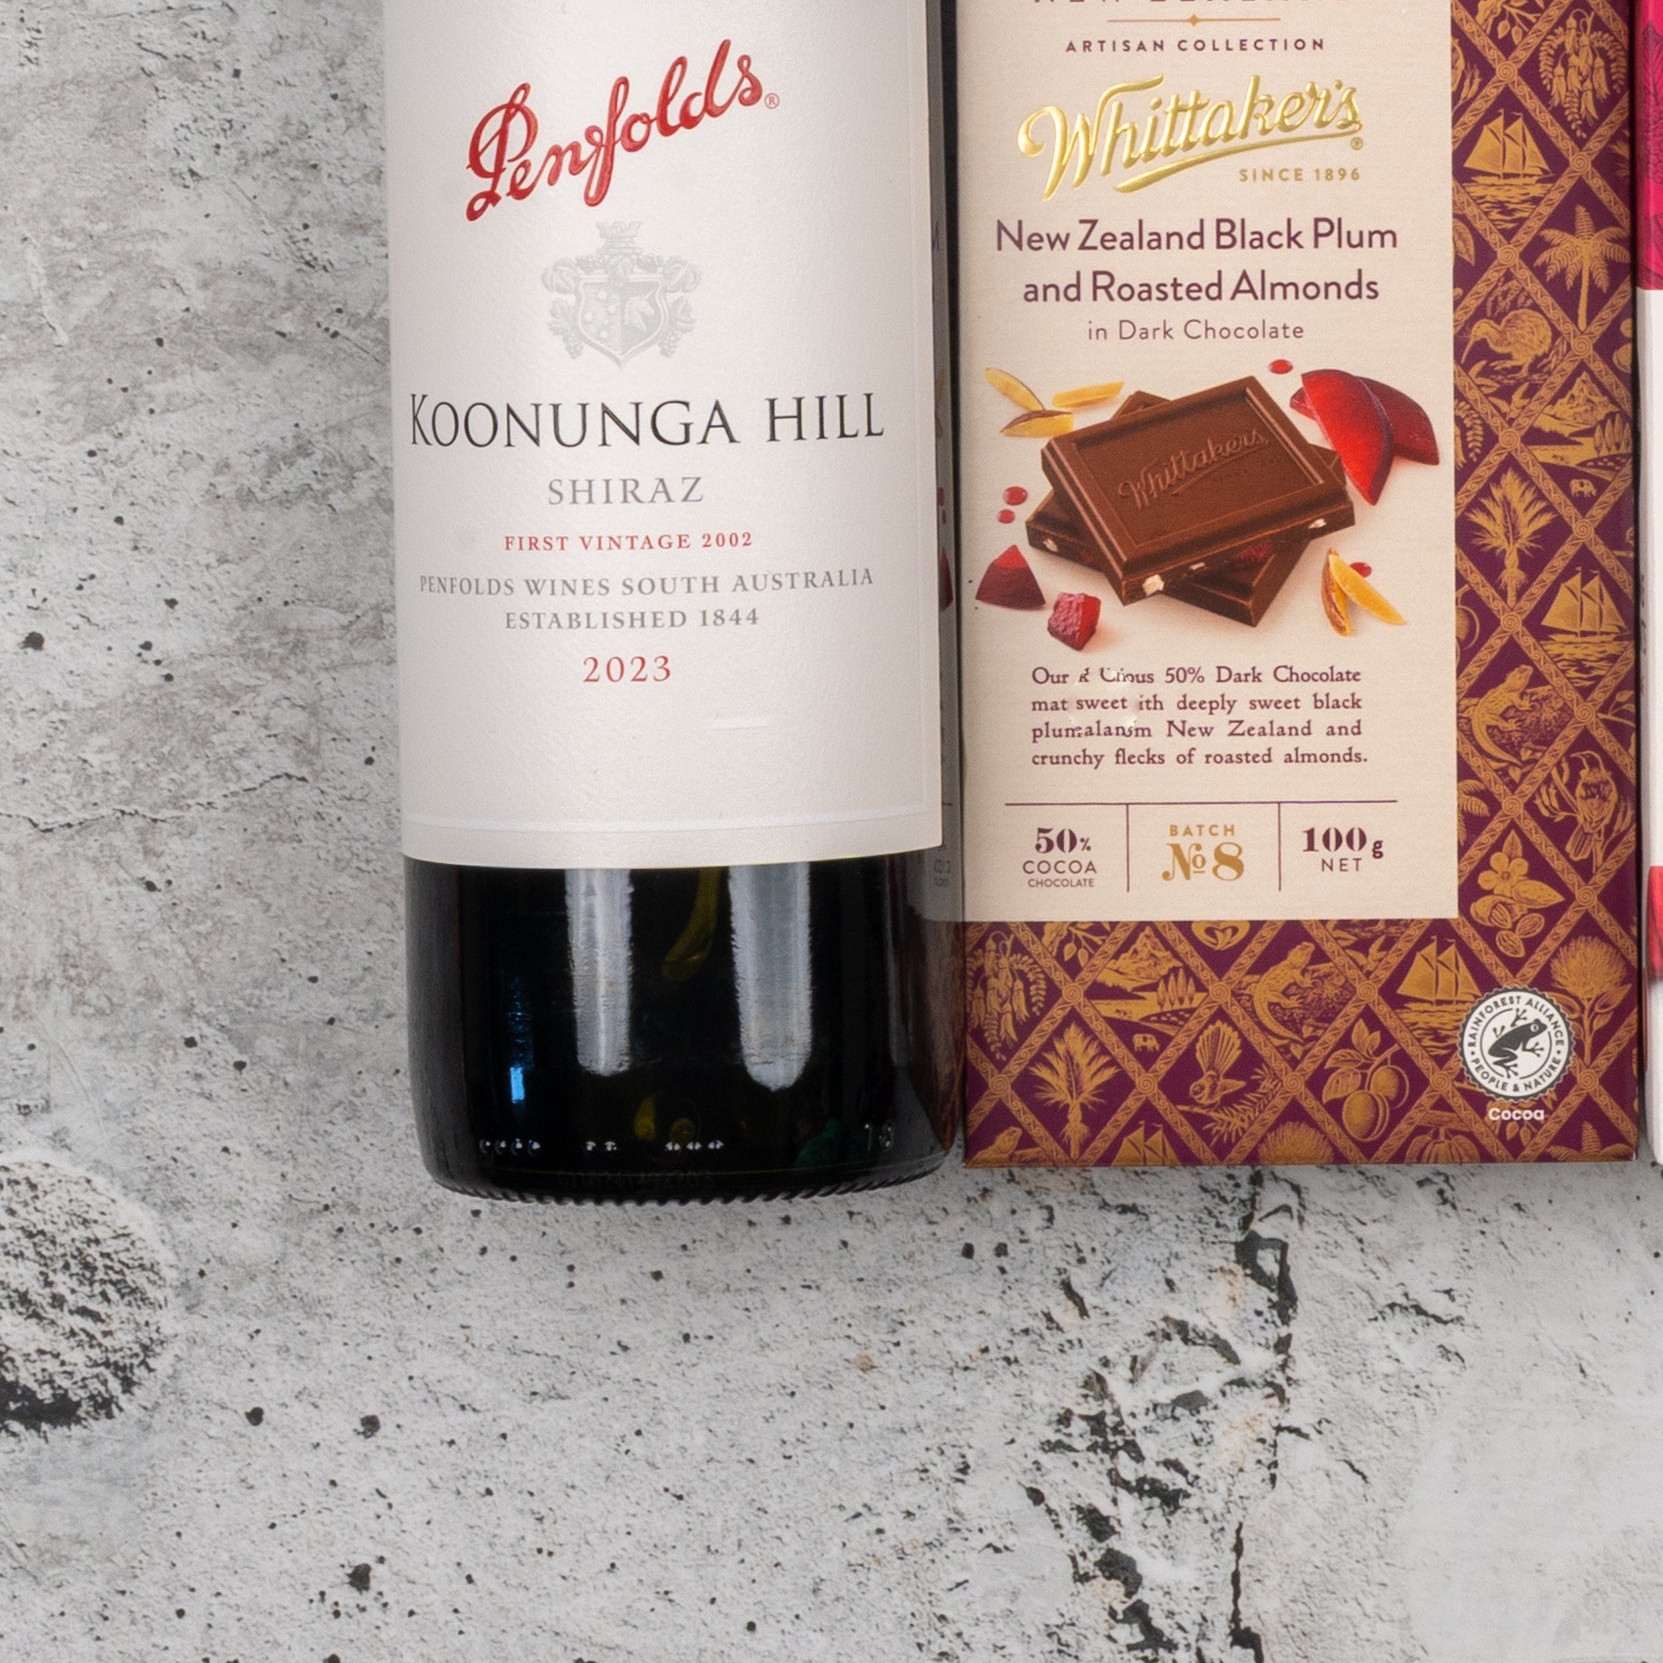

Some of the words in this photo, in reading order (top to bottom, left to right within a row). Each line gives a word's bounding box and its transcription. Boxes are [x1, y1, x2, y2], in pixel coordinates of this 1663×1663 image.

[1066, 40, 1163, 52] ARTISAN
[1178, 39, 1323, 51] COLLECTION
[466, 39, 767, 221] Penfolds
[1239, 168, 1303, 182] SINCE
[1315, 168, 1359, 181] 1896
[997, 220, 1070, 251] New
[1078, 219, 1204, 250] Zealand
[1216, 218, 1304, 249] Black
[1314, 217, 1397, 248] Plum
[1024, 271, 1081, 302] and
[1093, 270, 1222, 302] Roasted
[1230, 269, 1379, 300] Almonds
[1089, 321, 1107, 340] in
[1119, 320, 1173, 340] Dark
[1184, 319, 1303, 339] Chocolate
[411, 394, 739, 447] KOONUNGA
[765, 392, 885, 443] HILL
[549, 477, 703, 505] SHIRAZ
[505, 536, 568, 550] FIRST
[580, 534, 690, 550] VINTAGE
[702, 532, 751, 547] 2002
[420, 575, 513, 595] PENFOLDS
[524, 579, 609, 596] WINES
[623, 576, 718, 595] SOUTH
[733, 568, 874, 591] AUSTRALIA
[506, 611, 686, 629] ESTABLISHED
[699, 608, 760, 627] 1844
[584, 656, 670, 682] 2023
[1032, 667, 1069, 684] Our
[1165, 667, 1204, 683] 50%
[1216, 666, 1262, 682] Dark
[1273, 665, 1360, 682] Chocolate
[1076, 698, 1127, 710] sweet
[1177, 694, 1237, 715] deeply
[1249, 697, 1300, 710] sweet
[1313, 693, 1361, 709] black
[1167, 720, 1214, 737] New
[1228, 720, 1312, 736] Zealand
[1326, 719, 1361, 736] and
[1032, 748, 1104, 769] crunchy
[1115, 748, 1165, 764] flecks
[1176, 747, 1196, 764] of
[1205, 747, 1272, 764] roasted
[1284, 747, 1367, 763] almonds.
[1035, 828, 1091, 853] 50%
[1170, 825, 1234, 836] BATCH
[1023, 860, 1096, 874] COCOA
[1322, 858, 1362, 872] NET
[1028, 877, 1094, 888] CHOCOLATE
[1467, 995, 1521, 1048] RAINFOREST
[1526, 999, 1564, 1046] ALLIANCE
[1471, 1057, 1507, 1092] PEOPLE
[1513, 1084, 1520, 1092] &
[1524, 1056, 1561, 1091] NATURE
[1488, 1108, 1545, 1121] Cocoa
